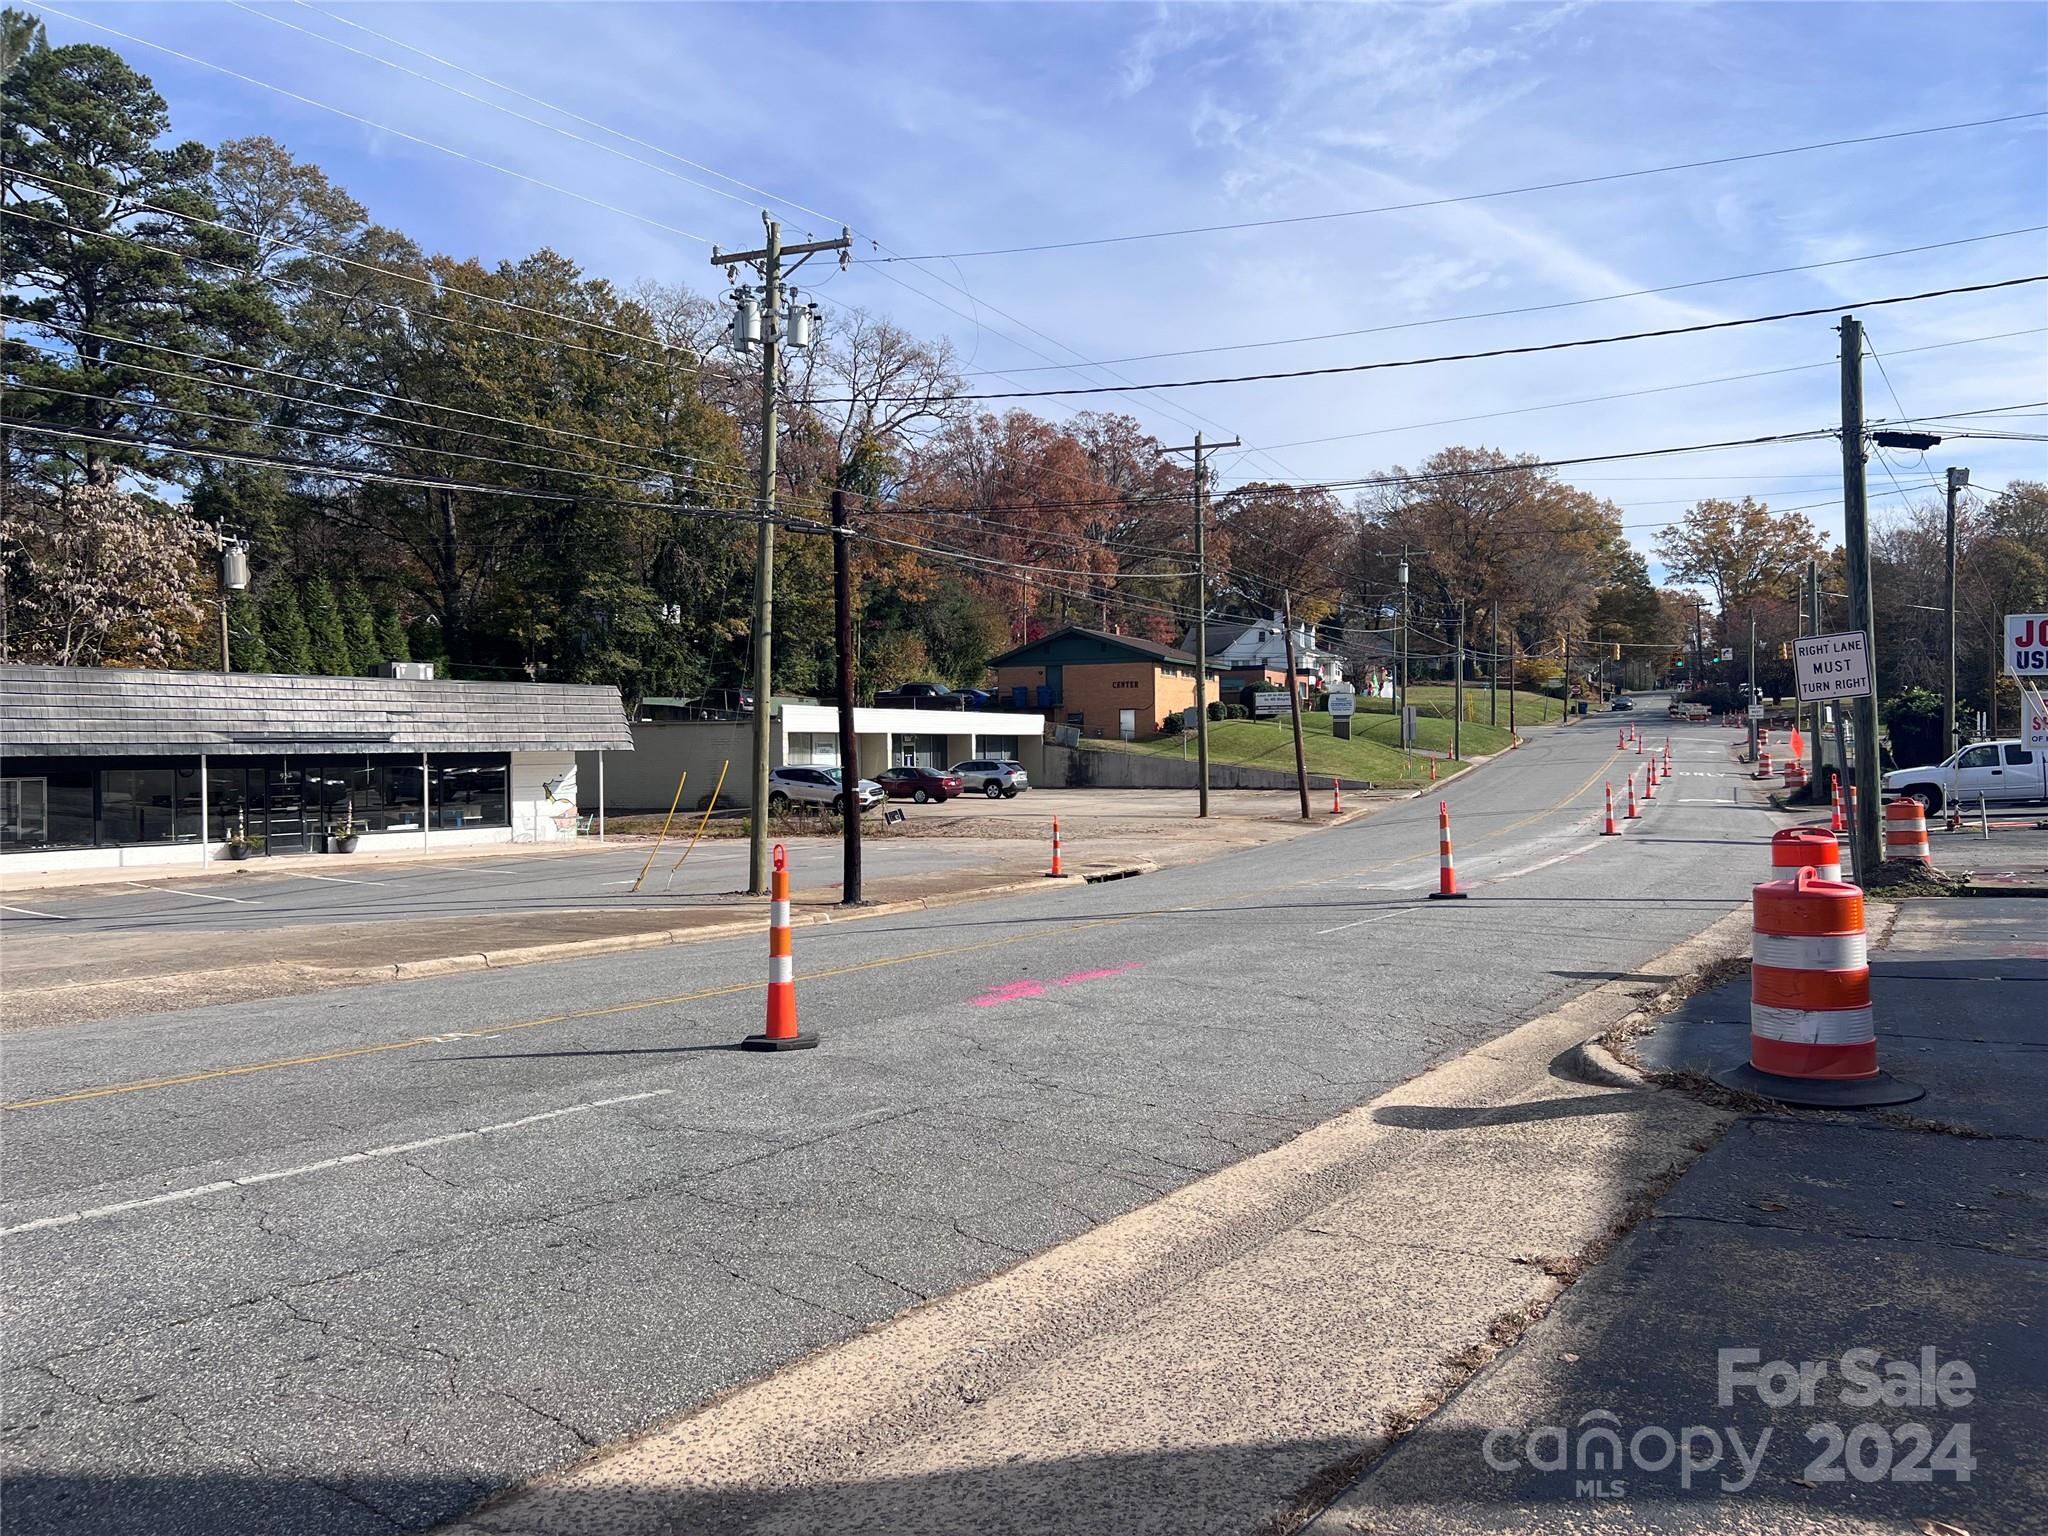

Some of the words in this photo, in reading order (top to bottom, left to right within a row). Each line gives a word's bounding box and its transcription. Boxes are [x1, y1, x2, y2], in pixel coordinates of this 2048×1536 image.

[1798, 644, 1829, 656] RIGHT
[1833, 641, 1862, 653] LANE
[1813, 659, 1851, 674] MUST
[2016, 651, 2048, 669] US
[1801, 681, 1830, 694] TURN
[1834, 677, 1866, 690] RIGHT
